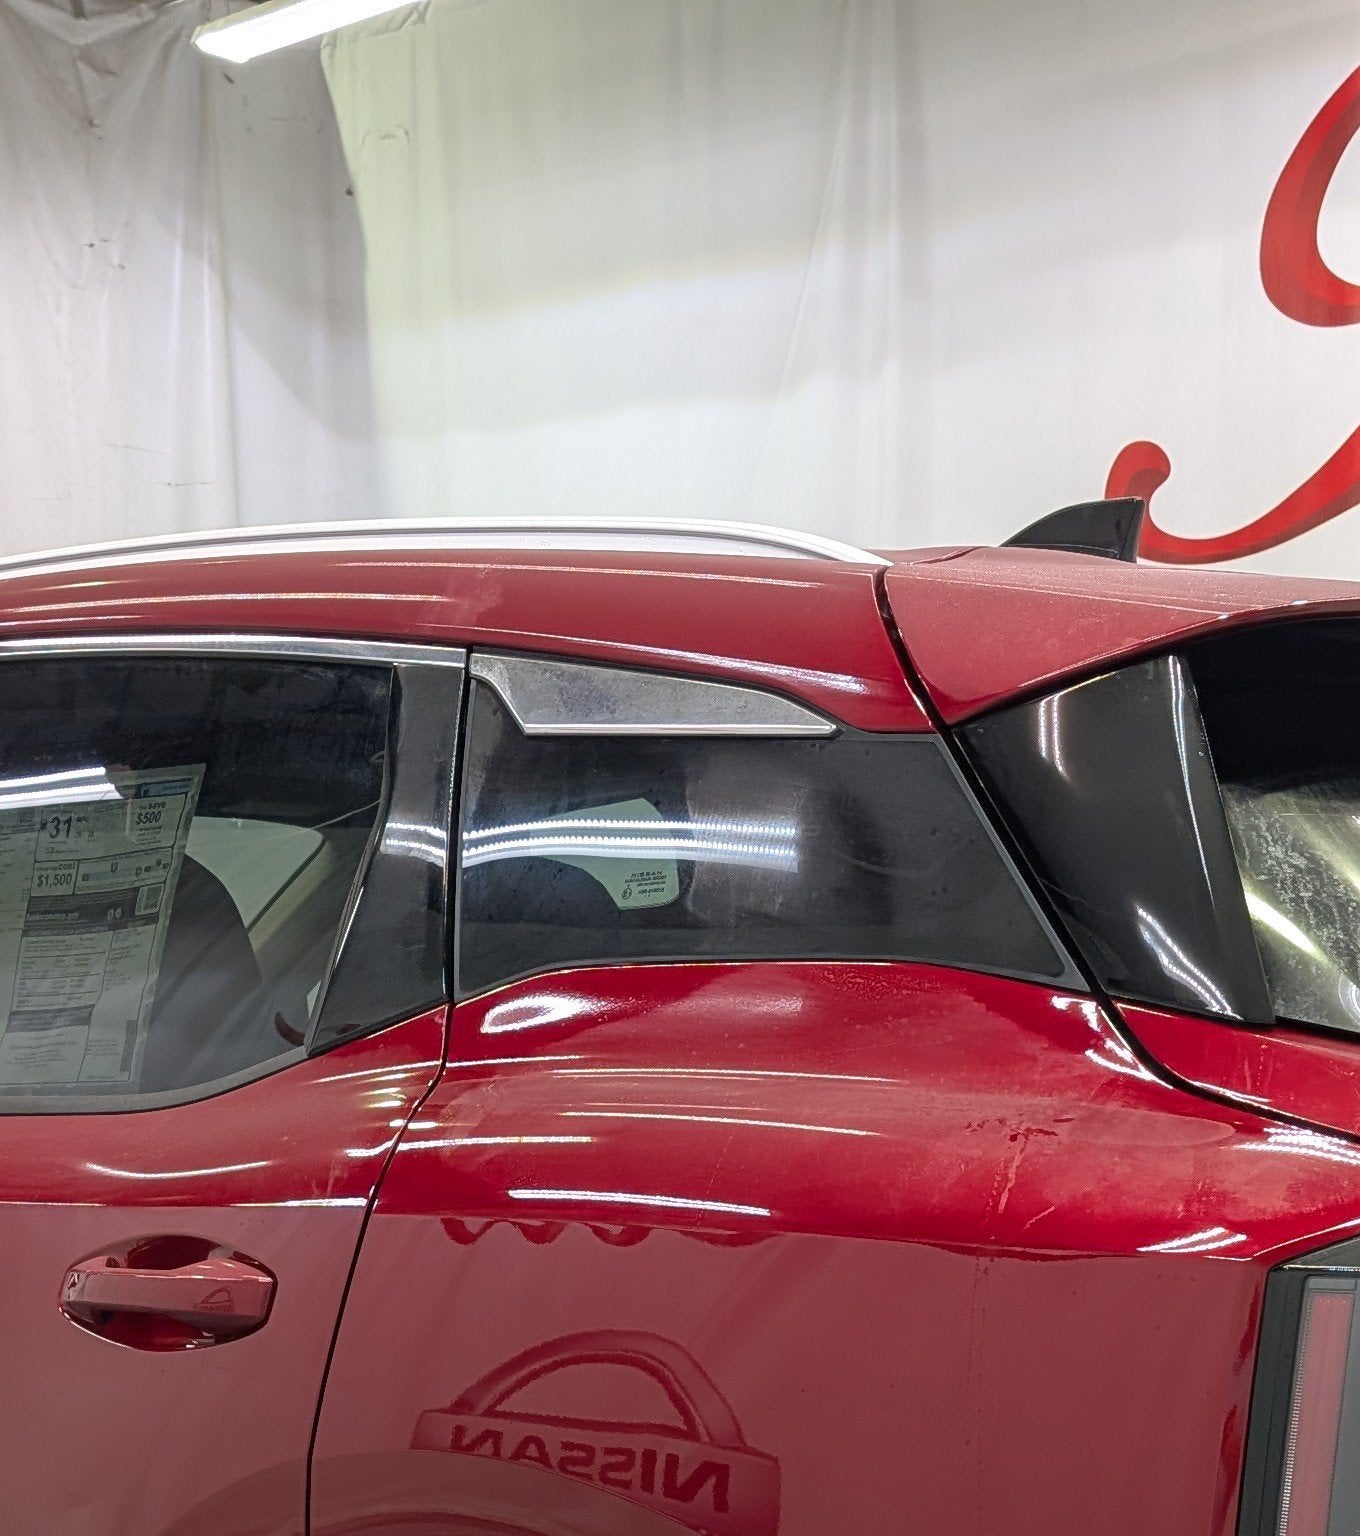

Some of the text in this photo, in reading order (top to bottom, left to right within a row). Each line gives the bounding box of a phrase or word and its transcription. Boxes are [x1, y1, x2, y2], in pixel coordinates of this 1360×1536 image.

[136, 810, 162, 825] $500
[48, 816, 72, 839] 31
[37, 872, 73, 888] $1,500
